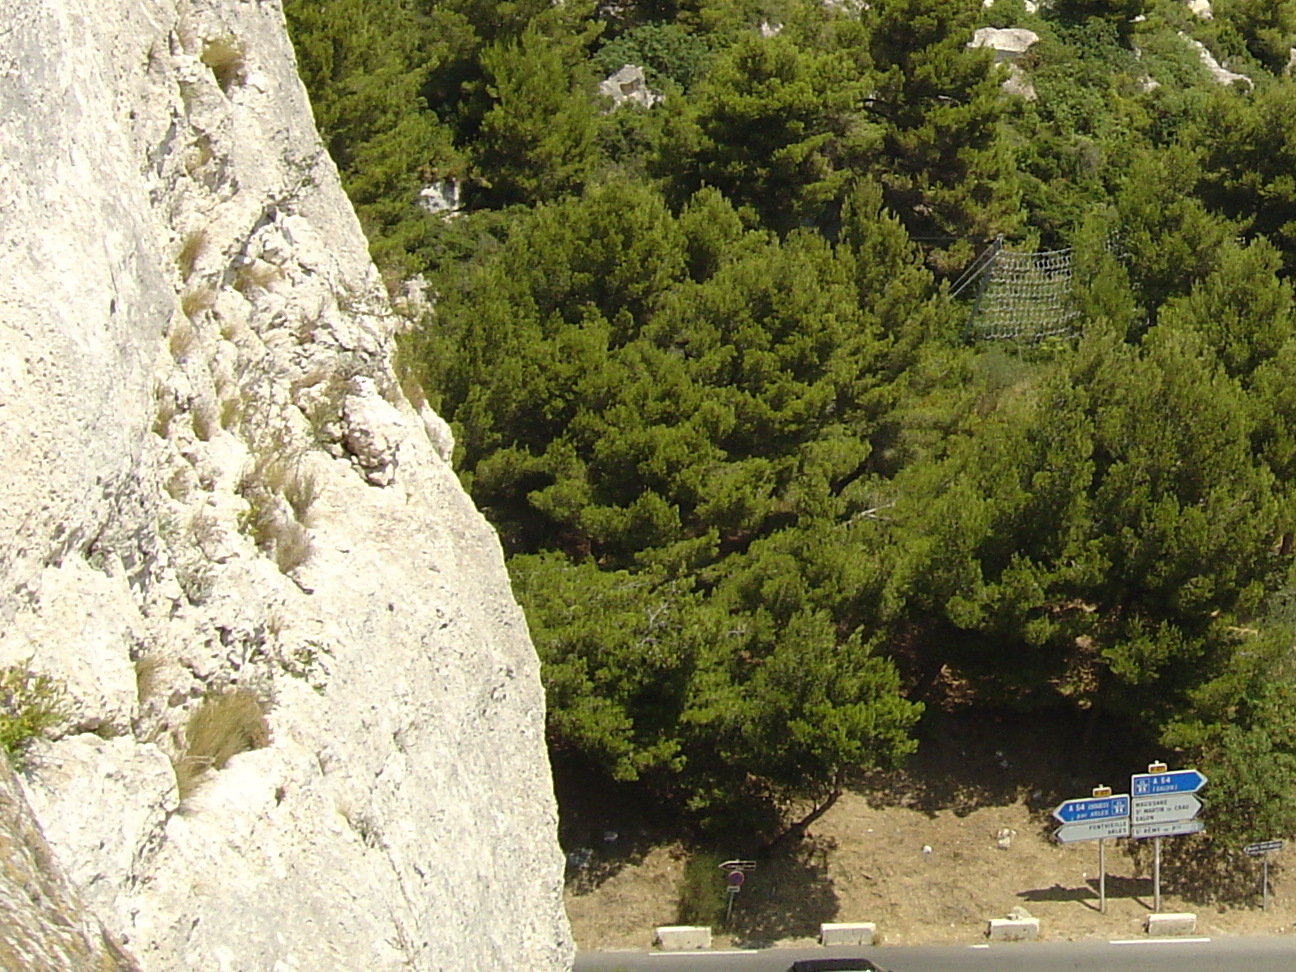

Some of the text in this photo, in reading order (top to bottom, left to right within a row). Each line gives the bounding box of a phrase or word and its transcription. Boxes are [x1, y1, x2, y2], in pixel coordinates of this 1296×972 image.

[1068, 804, 1074, 812] A
[1075, 803, 1085, 812] 54
[1143, 806, 1165, 814] MARTIN
[1090, 809, 1109, 817] ARLES
[1088, 821, 1127, 831] FONTVIEILLE
[1107, 827, 1127, 835] ARLES
